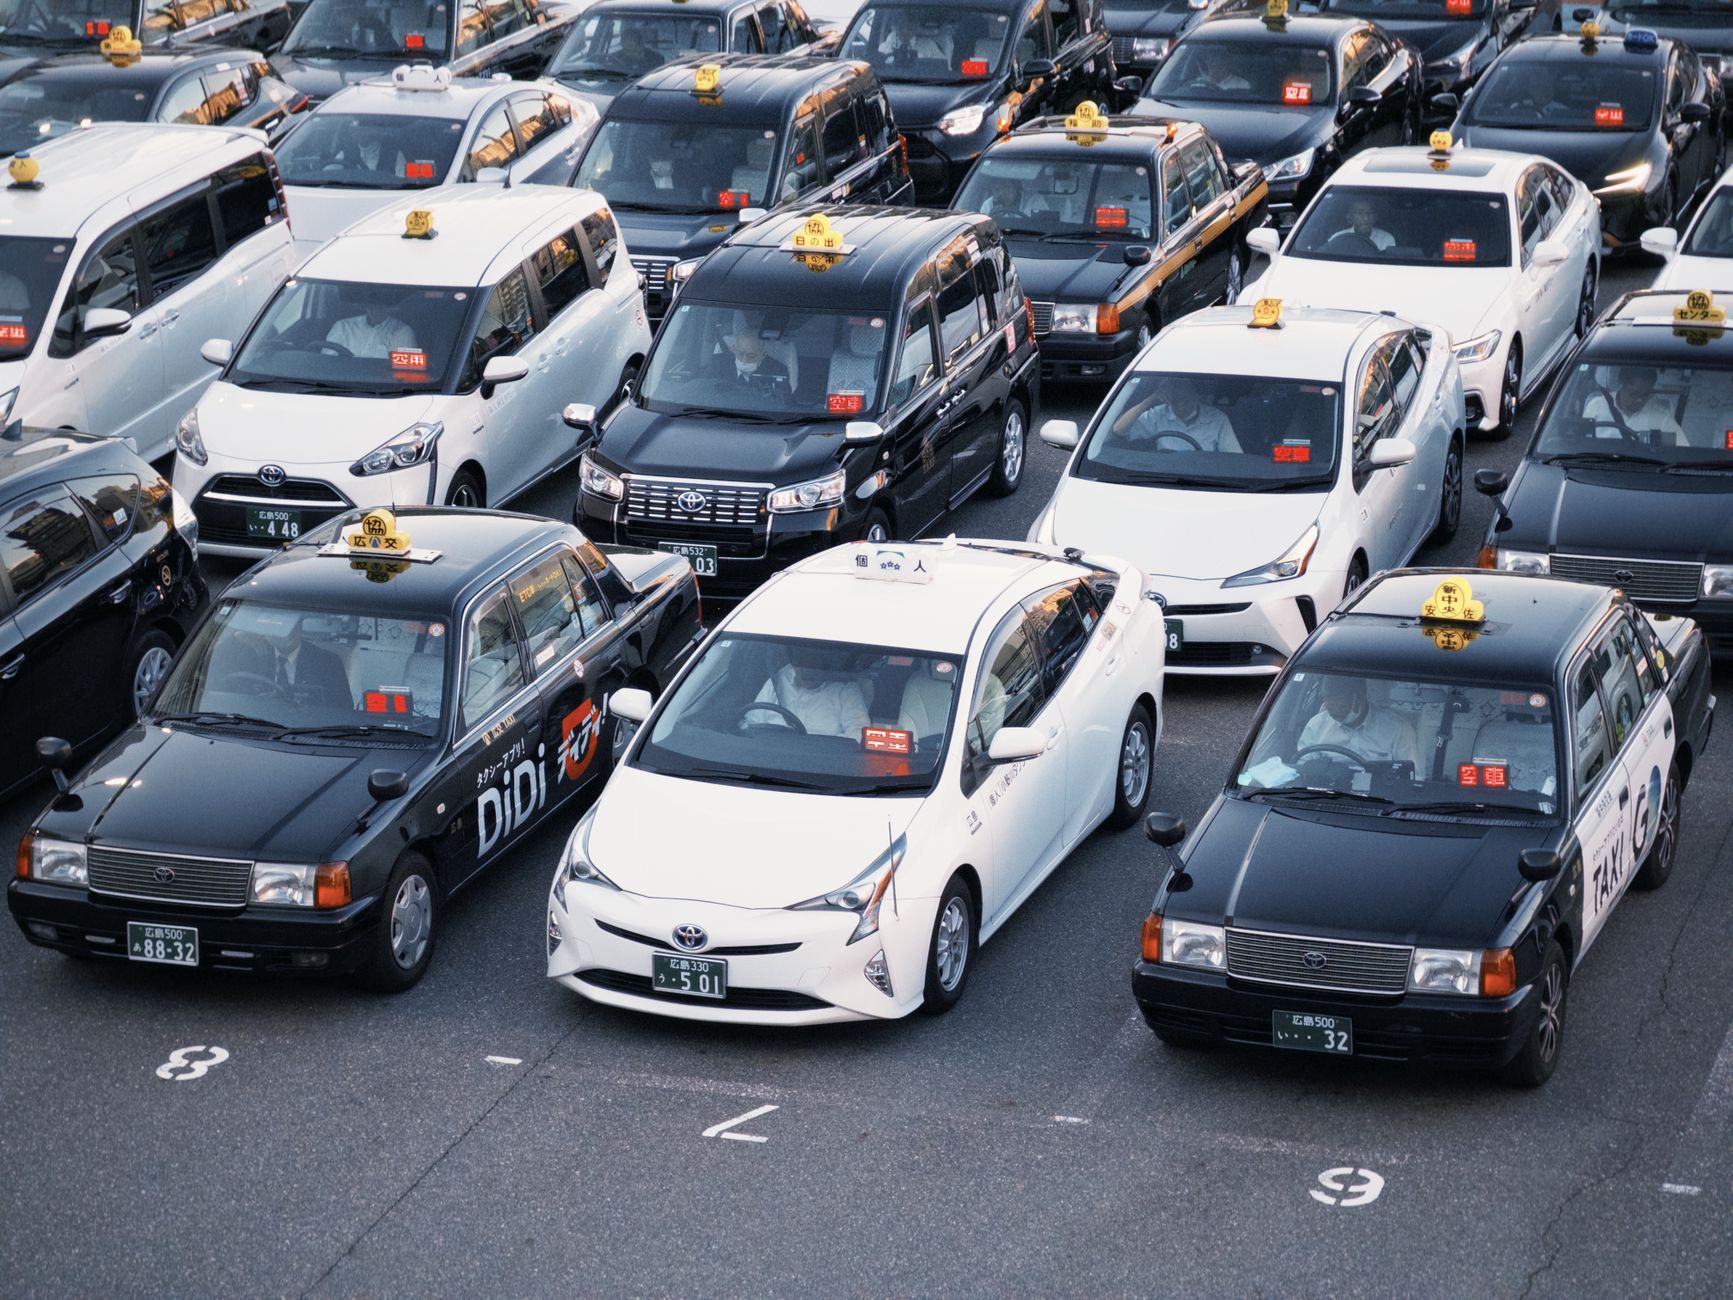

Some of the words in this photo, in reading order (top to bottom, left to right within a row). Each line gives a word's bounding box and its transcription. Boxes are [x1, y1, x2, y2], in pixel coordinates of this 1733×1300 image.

[796, 236, 834, 247] 日の出
[1677, 310, 1719, 320] センター
[365, 519, 384, 534] 協
[477, 742, 547, 860] DiDi
[1593, 831, 1624, 916] TAXI
[145, 927, 183, 940] 広島500
[144, 938, 195, 962] 88-32
[670, 959, 709, 973] 広島330
[1292, 1015, 1335, 1029] 広島500
[156, 1045, 230, 1080] 8
